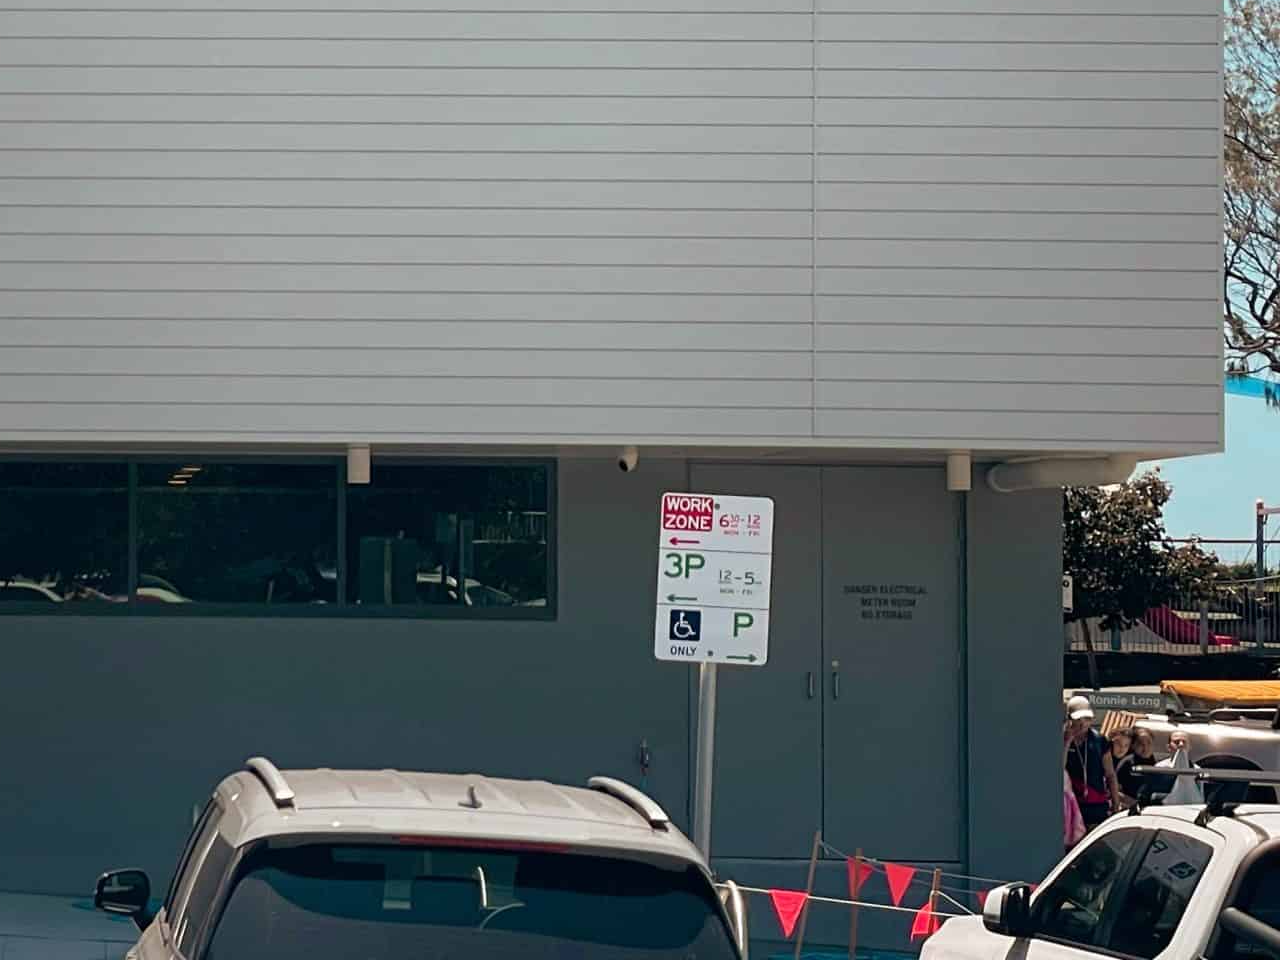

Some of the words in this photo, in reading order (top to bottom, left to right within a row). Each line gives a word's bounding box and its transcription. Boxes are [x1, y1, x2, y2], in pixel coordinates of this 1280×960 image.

[666, 496, 712, 512] WORK
[665, 514, 711, 530] ZONE
[663, 552, 706, 579] 3P
[733, 612, 754, 637] P
[670, 645, 697, 657] ONLY
[1089, 695, 1128, 705] Ronnie
[1132, 695, 1161, 708] Long
